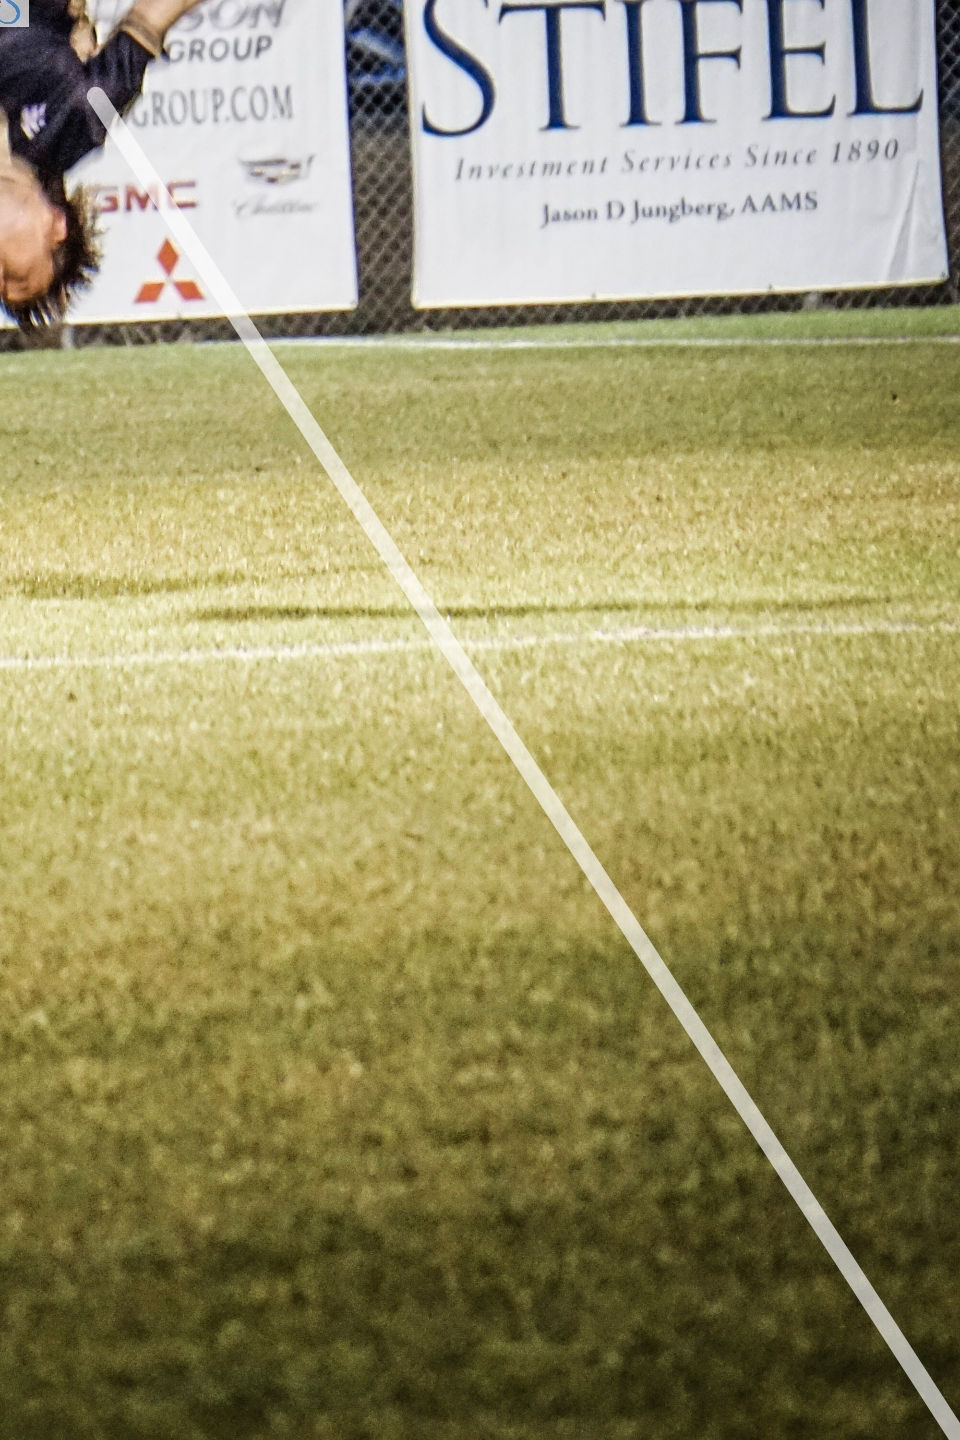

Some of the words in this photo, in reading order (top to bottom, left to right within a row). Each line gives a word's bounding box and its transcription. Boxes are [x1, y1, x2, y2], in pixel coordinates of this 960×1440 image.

[168, 35, 272, 63] GROUP
[455, 156, 608, 180] Investment
[621, 149, 731, 173] Services
[745, 143, 817, 167] Since
[832, 138, 898, 163] 1890
[93, 180, 198, 212] GMC
[540, 203, 598, 229] Jason
[606, 200, 625, 220] D
[631, 197, 735, 224] Jungberg,
[741, 191, 819, 213] AAMS
